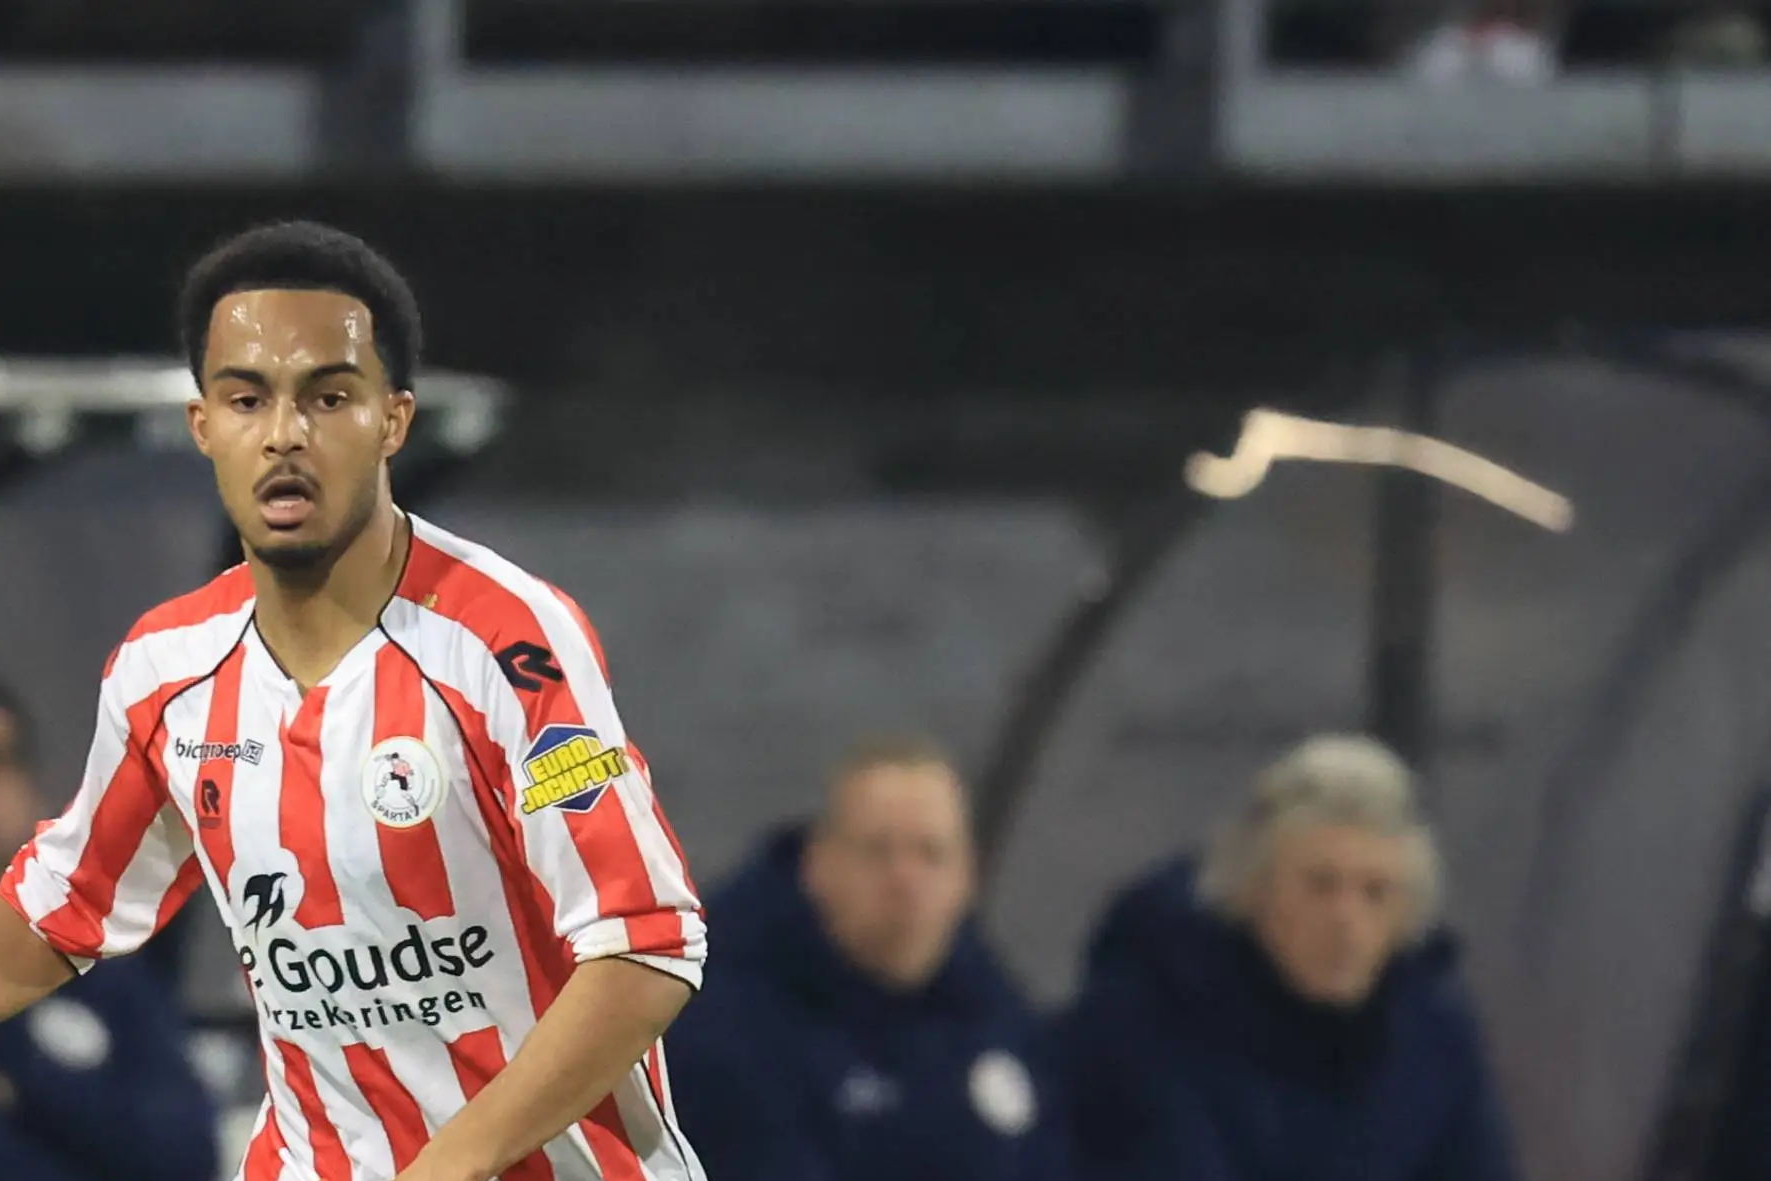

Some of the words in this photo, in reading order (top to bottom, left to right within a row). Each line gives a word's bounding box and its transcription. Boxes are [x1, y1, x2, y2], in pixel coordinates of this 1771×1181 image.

[522, 749, 622, 814] JACKPOT
[528, 738, 590, 784] EURO
[371, 796, 414, 821] SPARTA
[268, 925, 495, 993] Goudse
